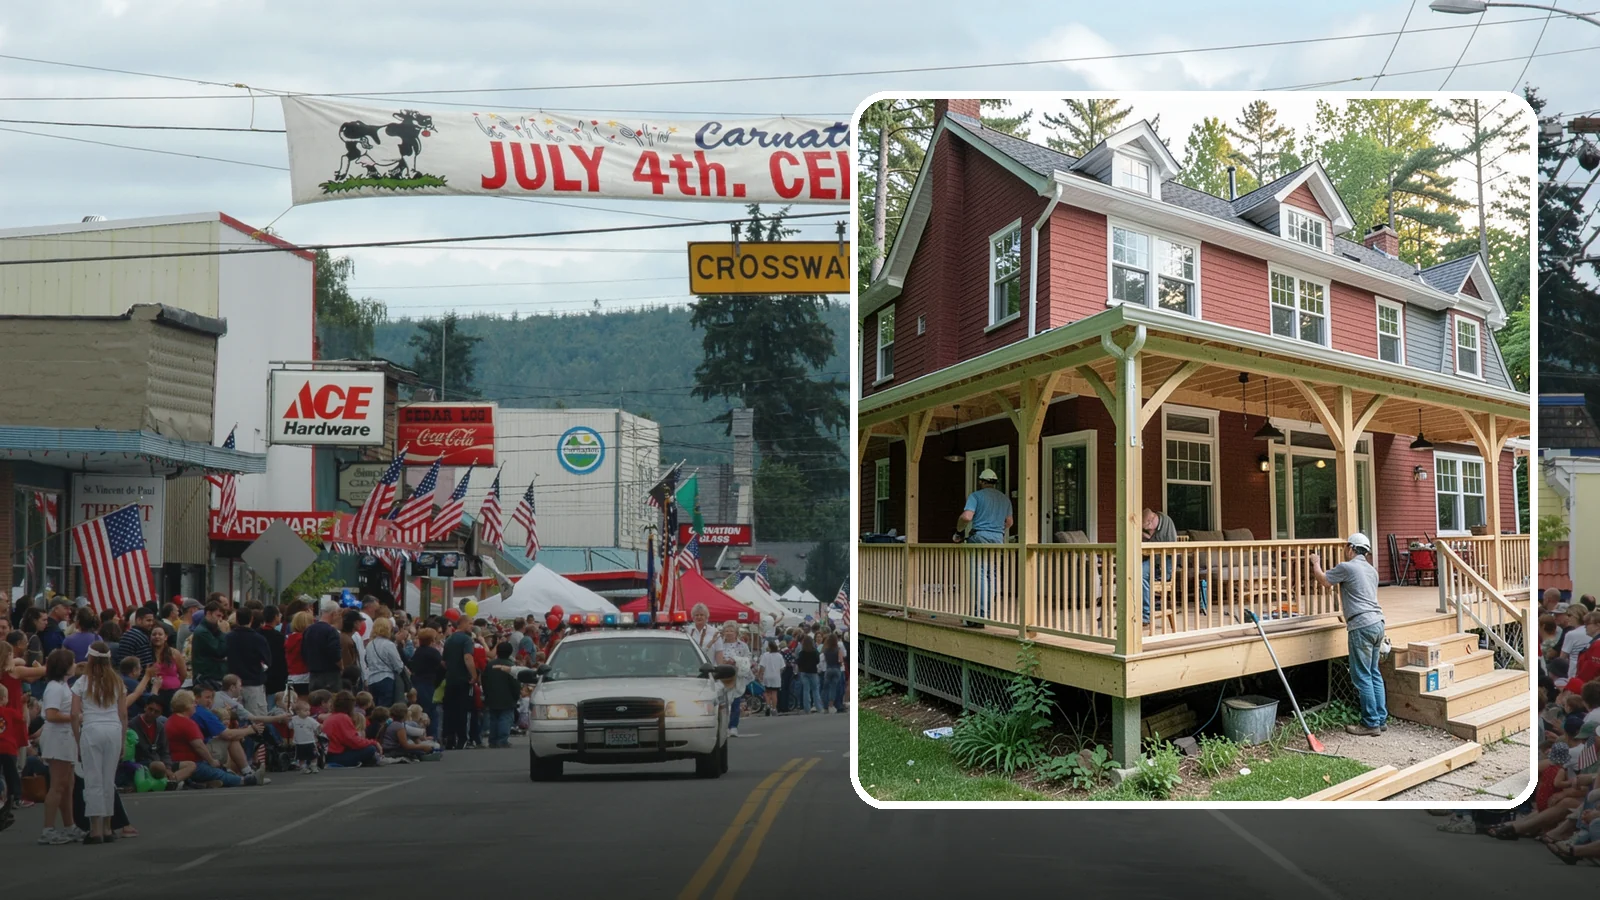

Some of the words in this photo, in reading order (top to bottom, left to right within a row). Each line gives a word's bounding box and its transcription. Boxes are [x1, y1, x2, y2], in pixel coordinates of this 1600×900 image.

[695, 121, 850, 150] Carnat
[481, 141, 605, 191] JULY
[632, 150, 746, 198] 4th.
[697, 254, 850, 281] CROSSWA
[283, 380, 373, 420] ACE
[405, 409, 453, 422] CEDAR
[283, 421, 370, 437] Hardware
[416, 428, 477, 447] Coca-Cola
[353, 467, 385, 482] Simpl
[83, 485, 93, 494] St.
[95, 485, 124, 495] Vincent
[126, 486, 136, 494] de
[137, 486, 155, 495] Paul
[688, 526, 741, 535] CRNATION
[698, 535, 730, 543] GLASS
